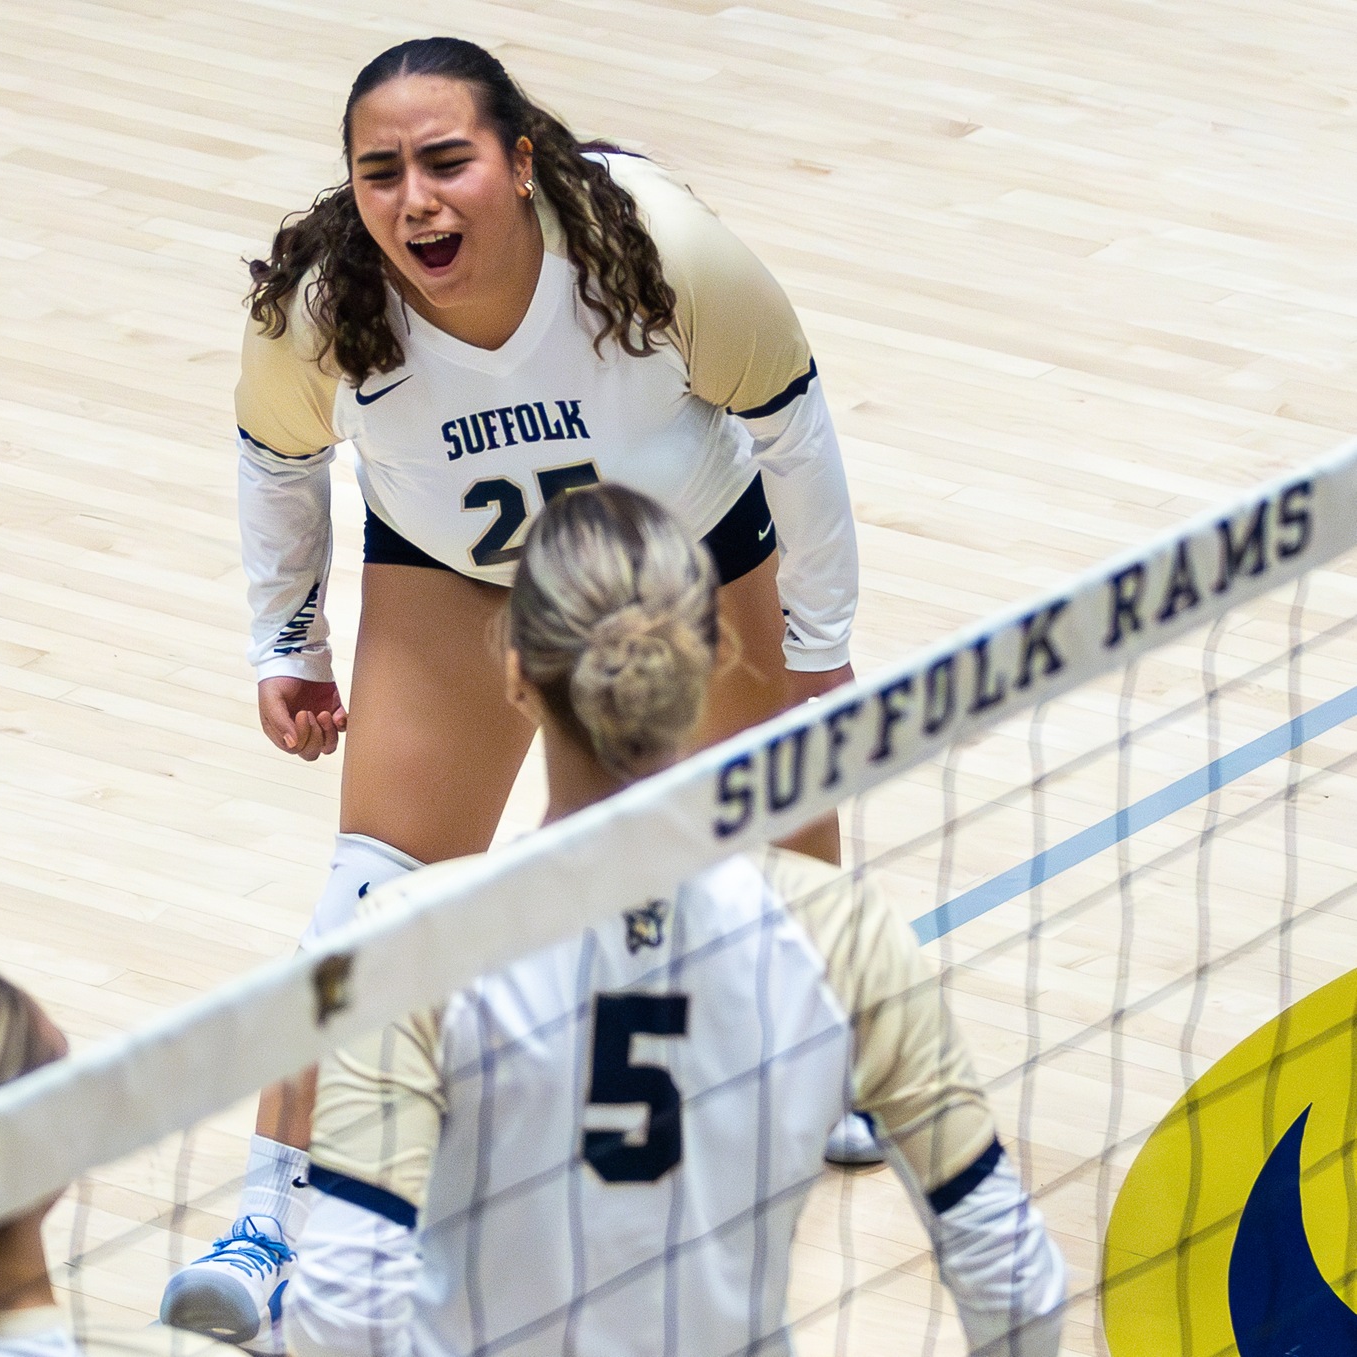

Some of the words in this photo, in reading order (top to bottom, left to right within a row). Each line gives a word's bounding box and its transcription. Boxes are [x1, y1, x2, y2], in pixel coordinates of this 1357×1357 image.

[441, 399, 591, 462] SUFFOLK
[711, 598, 1074, 840] SUFFOLK
[1103, 479, 1315, 650] RAMS
[582, 992, 690, 1183] 5
